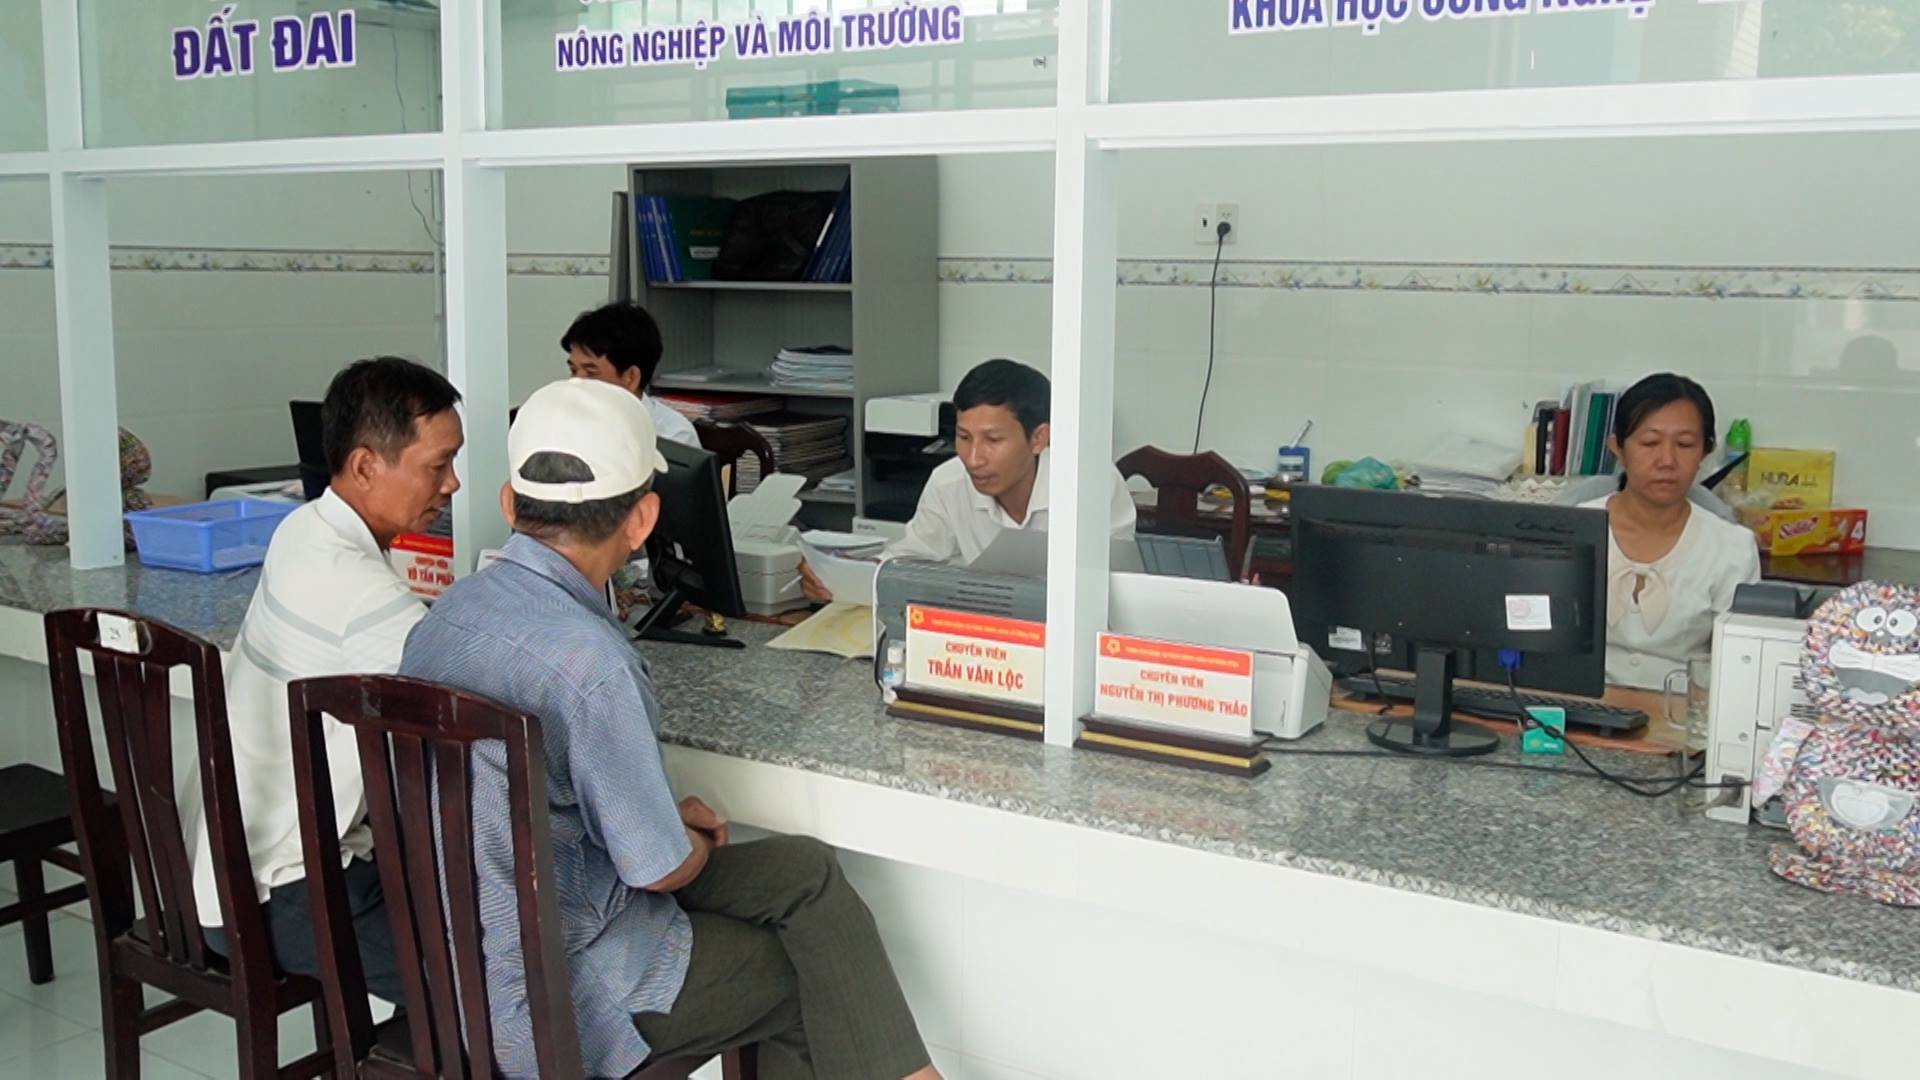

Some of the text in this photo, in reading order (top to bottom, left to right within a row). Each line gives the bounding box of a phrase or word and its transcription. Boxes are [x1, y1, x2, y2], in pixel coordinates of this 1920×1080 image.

[173, 6, 354, 76] ĐẤT ĐAI
[558, 1, 961, 68] NÔNG NGHIỆP VÀ MÔI TRƯỜNG
[985, 645, 1007, 661] VIÊN
[998, 668, 1025, 691] LỘC
[1182, 673, 1204, 689] VIÊN
